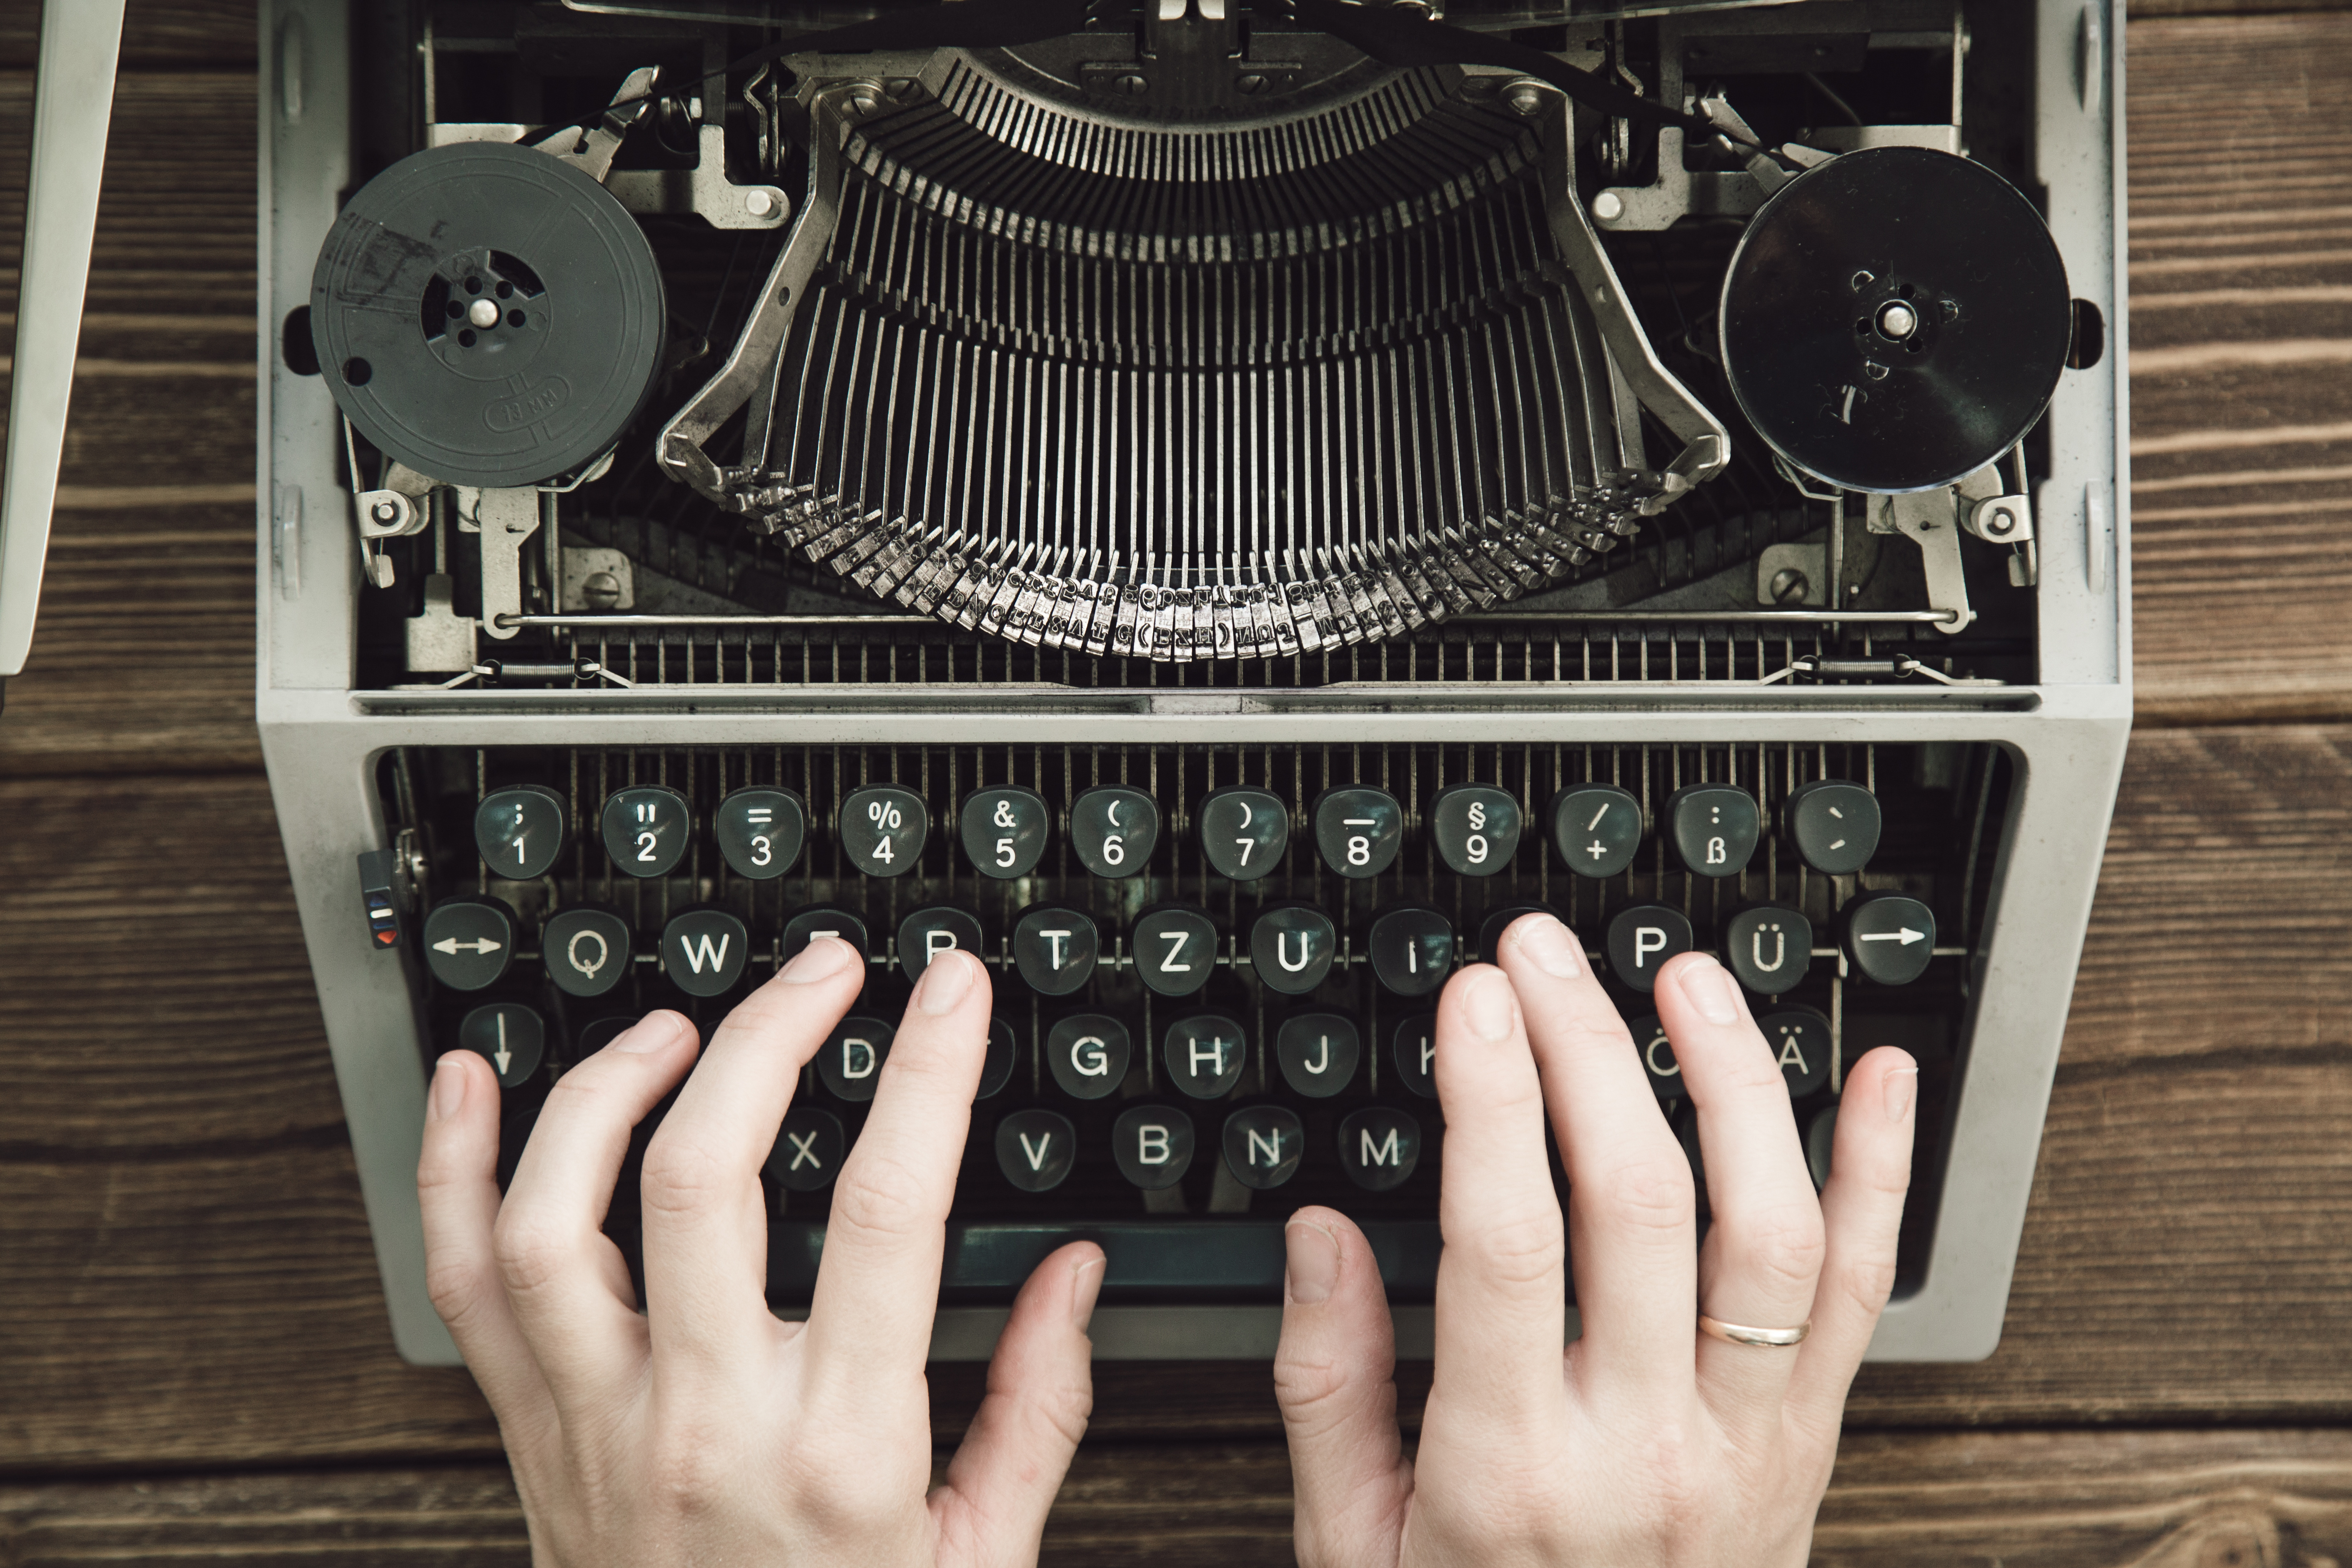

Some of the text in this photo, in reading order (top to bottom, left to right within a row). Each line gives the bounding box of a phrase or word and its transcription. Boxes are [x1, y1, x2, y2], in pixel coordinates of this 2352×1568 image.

[527, 389, 557, 413] MM
[748, 809, 771, 822] =
[869, 801, 901, 829] %
[994, 801, 1016, 827] &
[1108, 800, 1120, 826] (
[1240, 802, 1251, 829] )
[1468, 802, 1485, 830] §
[1588, 804, 1609, 831] /
[1712, 807, 1719, 823] :
[513, 837, 524, 864] 1
[638, 832, 656, 861] 2
[751, 836, 771, 865] 3
[872, 836, 894, 864] 4
[997, 839, 1015, 867] 5
[1104, 835, 1124, 865] 6
[1236, 839, 1254, 866] 7
[1348, 837, 1370, 865] 8
[1467, 835, 1488, 863] 9
[1587, 840, 1607, 859] +
[569, 930, 607, 979] Q
[681, 934, 729, 973] W
[1039, 930, 1071, 970] T
[1160, 932, 1190, 972] Z
[1279, 932, 1308, 971] U
[1636, 927, 1667, 968] P
[1753, 924, 1784, 972] Ü
[844, 1039, 874, 1078] D
[1072, 1037, 1107, 1075] G
[1190, 1037, 1222, 1076] H
[1305, 1036, 1328, 1074] J
[1778, 1026, 1809, 1075] Ä
[789, 1132, 820, 1170] X
[1020, 1133, 1050, 1170] V
[1140, 1126, 1170, 1164] B
[1249, 1128, 1279, 1166] N
[1362, 1129, 1400, 1166] M
